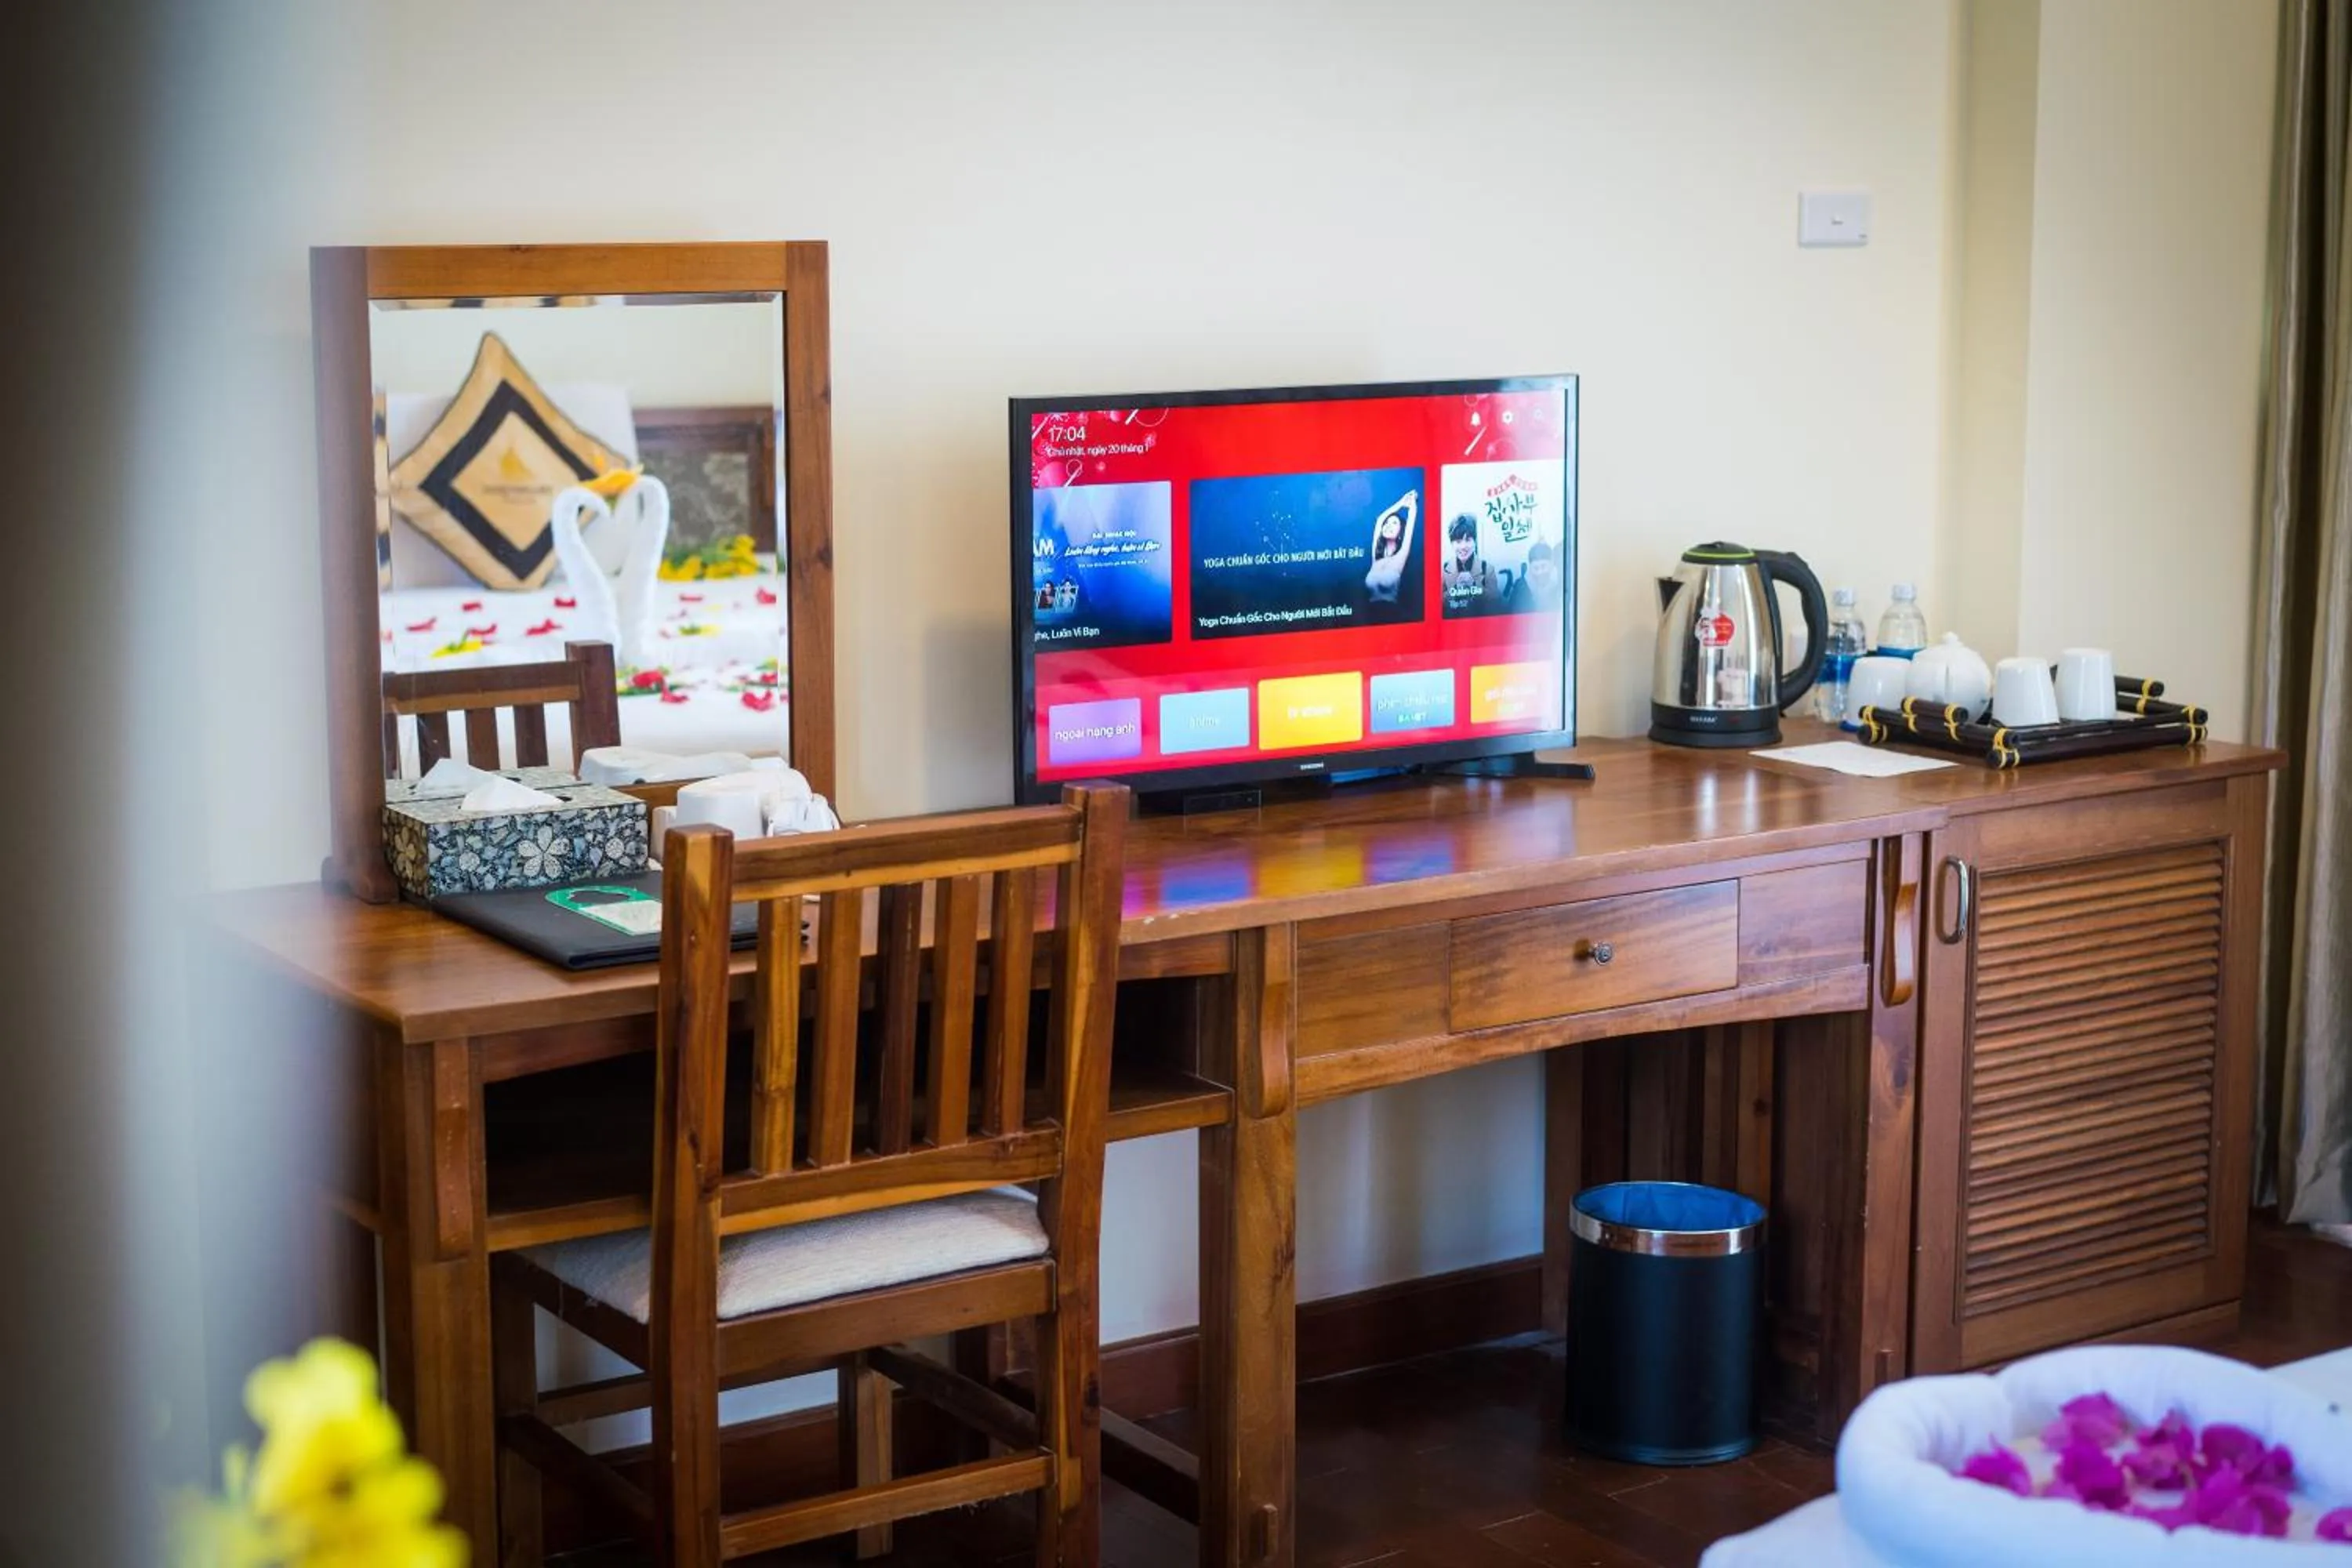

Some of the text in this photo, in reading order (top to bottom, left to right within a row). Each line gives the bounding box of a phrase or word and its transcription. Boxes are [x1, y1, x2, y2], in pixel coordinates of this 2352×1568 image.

[1048, 425, 1086, 442] 17:04
[1109, 445, 1120, 455] 20
[1203, 557, 1225, 568] YOGA
[1272, 553, 1290, 564] CHO
[1199, 616, 1219, 628] Yoga
[1264, 612, 1280, 622] Cho
